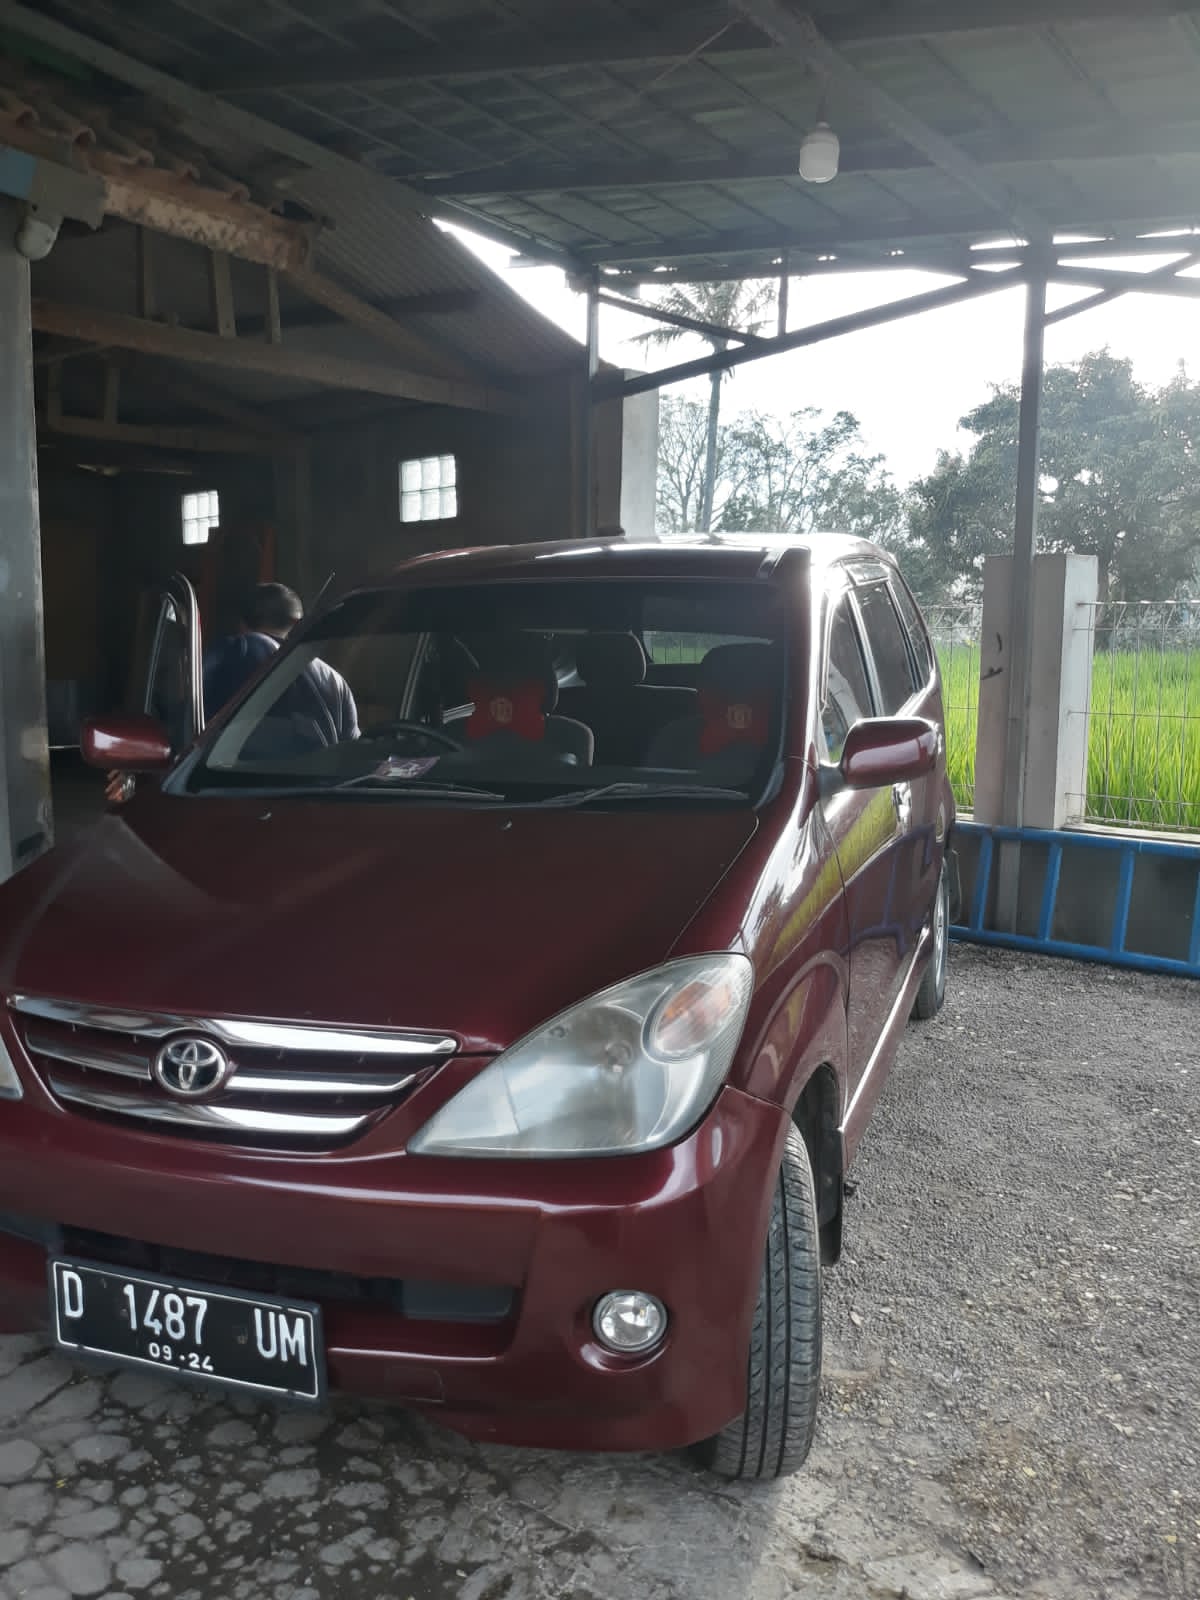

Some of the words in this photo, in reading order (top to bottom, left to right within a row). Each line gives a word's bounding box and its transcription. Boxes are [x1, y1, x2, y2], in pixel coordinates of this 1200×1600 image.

[62, 1271, 84, 1318] D
[123, 1284, 208, 1344] 1487
[254, 1308, 307, 1366] UM
